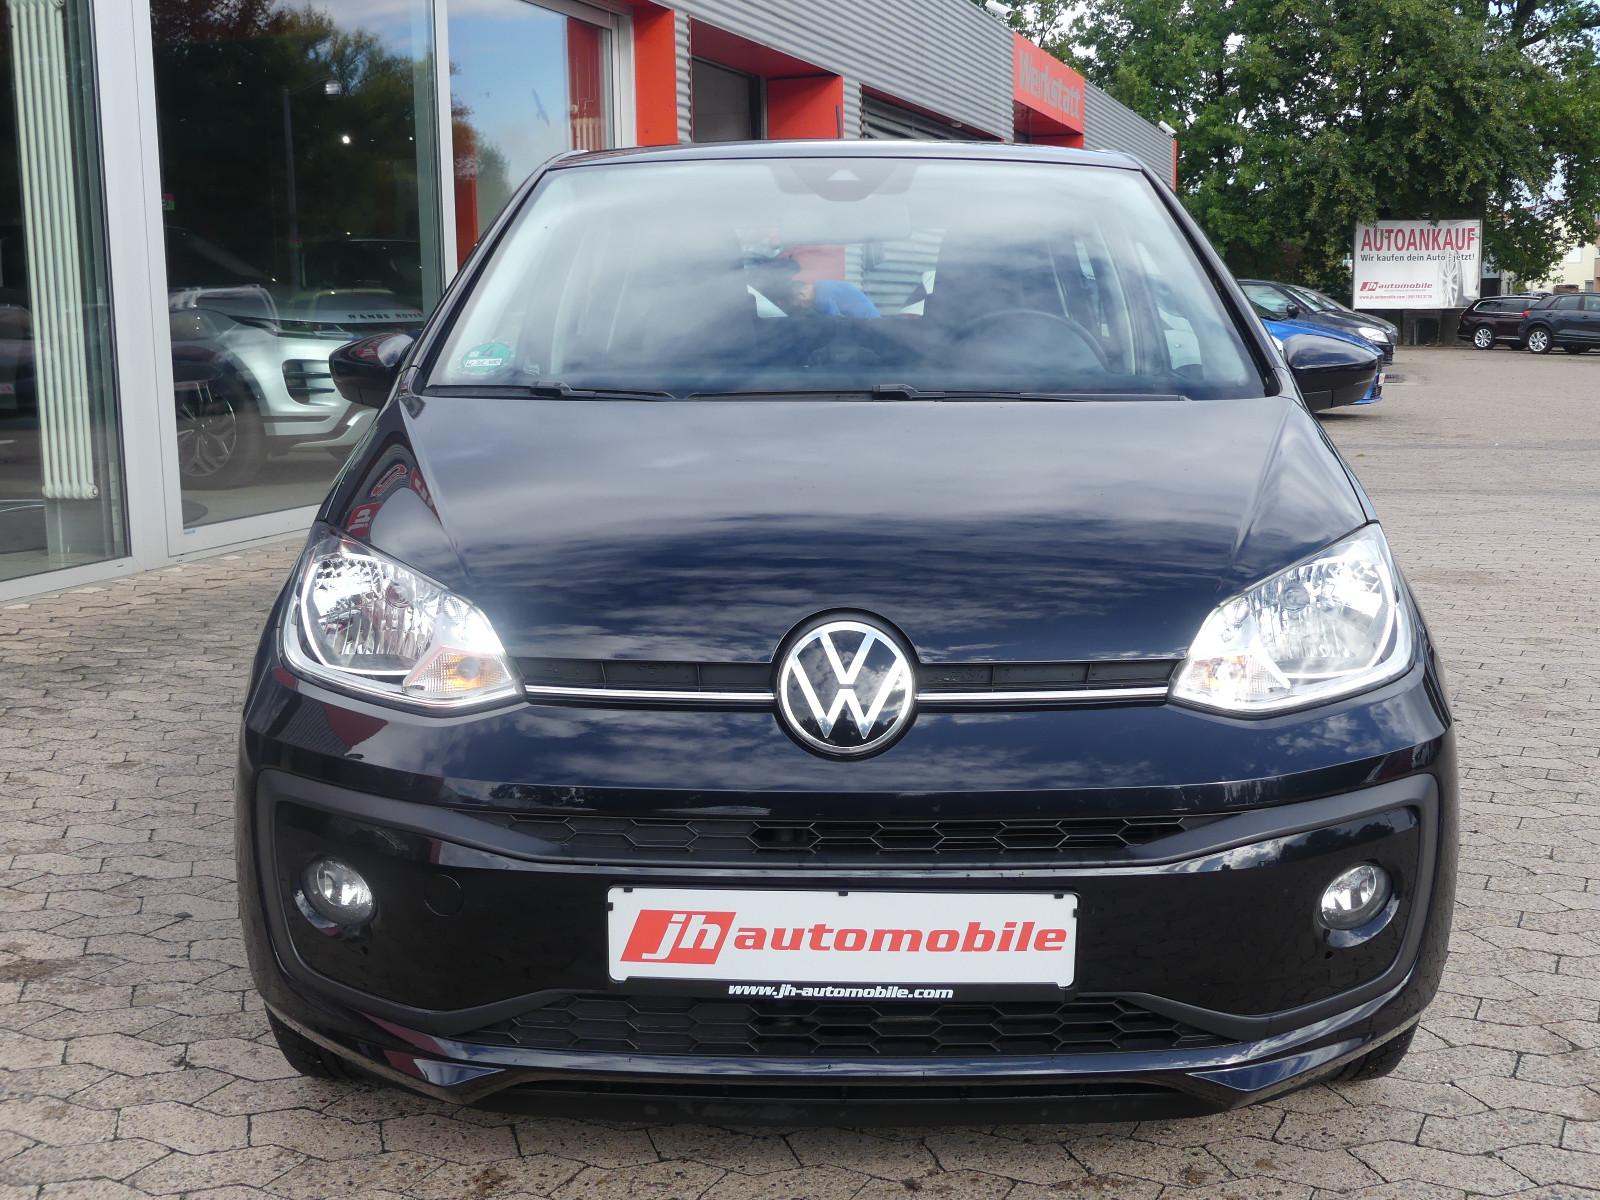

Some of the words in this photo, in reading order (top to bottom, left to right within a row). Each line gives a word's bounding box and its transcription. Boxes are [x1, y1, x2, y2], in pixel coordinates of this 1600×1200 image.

[1018, 47, 1080, 119] Werkstatt
[1361, 227, 1475, 251] AUTOANKAUF
[1360, 254, 1374, 262] Wir
[1376, 254, 1405, 262] kaufen
[1406, 254, 1425, 262] dein
[1453, 254, 1475, 262] jetzt!
[641, 912, 723, 960] jh
[734, 921, 1067, 953] automobile
[728, 983, 954, 999] www.jh-automobile.com
